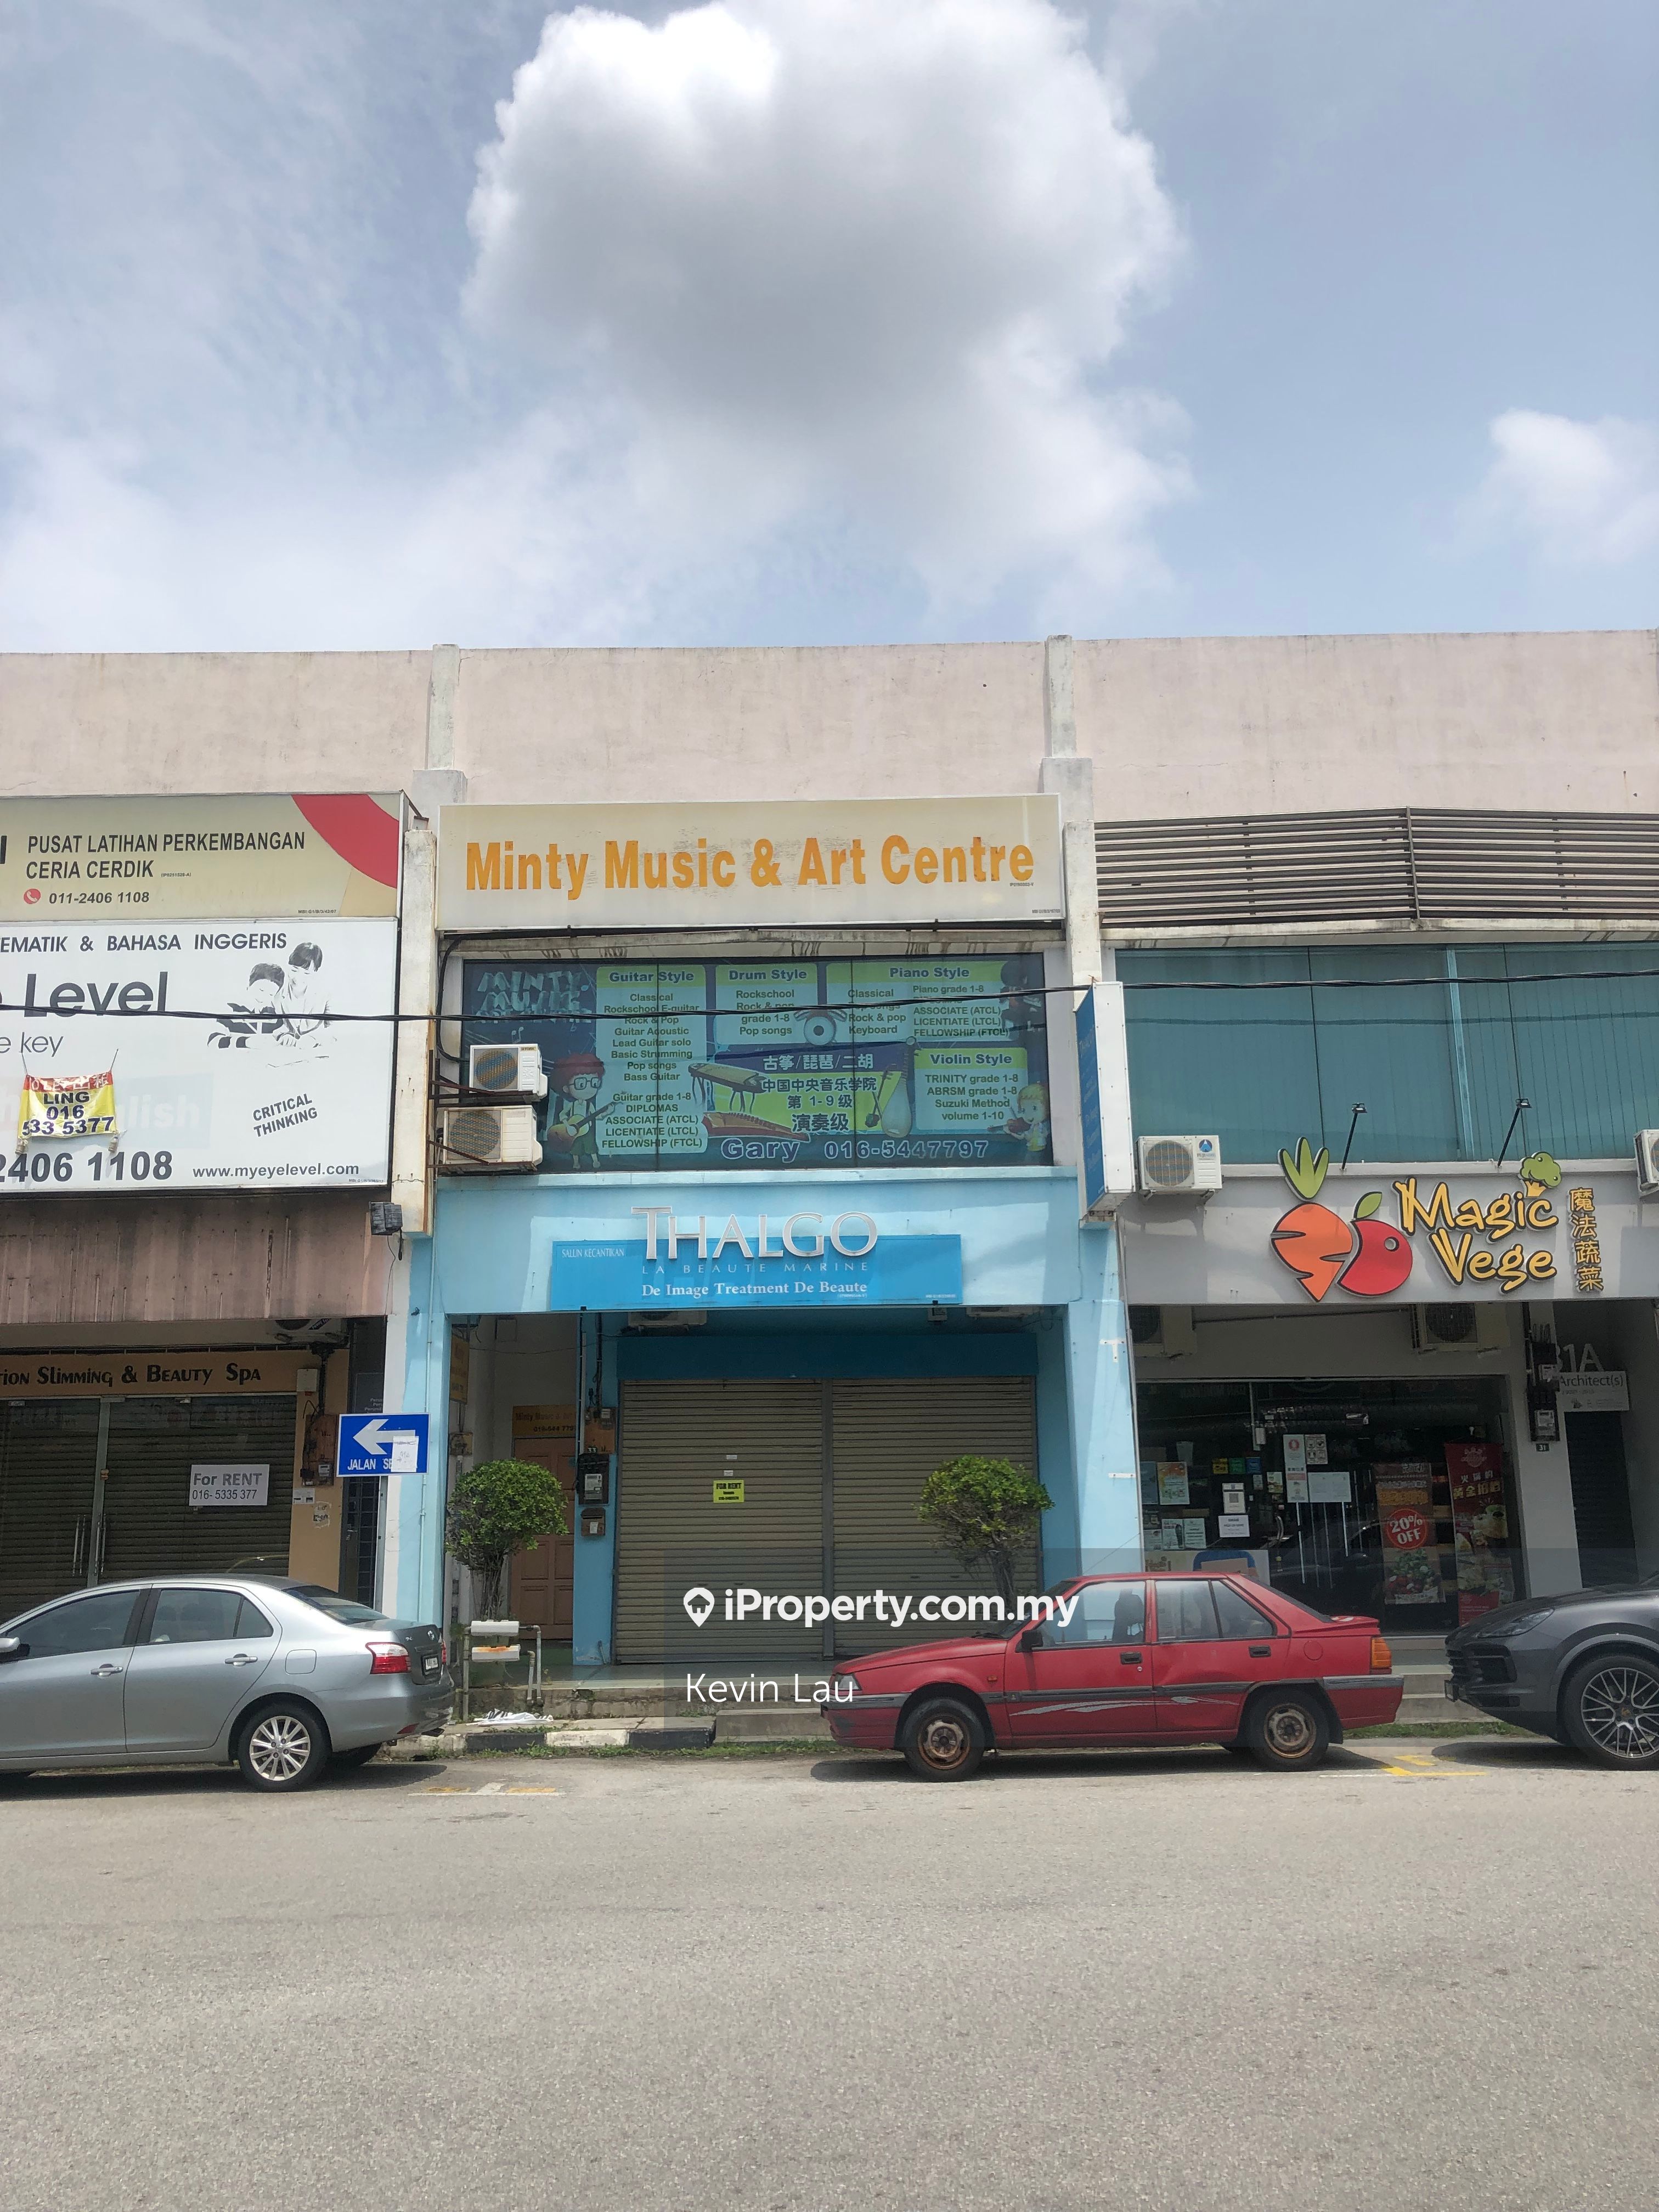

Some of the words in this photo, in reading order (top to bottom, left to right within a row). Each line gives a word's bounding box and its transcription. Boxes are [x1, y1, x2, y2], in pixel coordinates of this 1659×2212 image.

[28, 834, 83, 854] PUSAT
[88, 833, 158, 853] LATIHAN
[162, 832, 306, 852] PERKEMBANGAN
[26, 861, 81, 879] CERIA
[86, 860, 154, 878] CERDIK
[466, 841, 589, 900] Minty
[605, 838, 736, 888] Music
[751, 839, 782, 887] &
[798, 838, 866, 885] Art
[881, 835, 1034, 885] Centre
[49, 893, 112, 904] 011-2406
[118, 891, 150, 904] 1108
[0, 936, 68, 953] EMATIK
[80, 935, 94, 951] &
[107, 934, 181, 951] BAHASA
[194, 933, 287, 950] INGGERIS
[609, 972, 654, 982] Guitar
[658, 971, 694, 983] Style
[729, 970, 766, 980] Drum
[771, 969, 806, 981] Style
[890, 968, 929, 978] Piano
[934, 967, 969, 980] Style
[24, 972, 168, 1017] Level
[736, 990, 794, 998] Rockschool
[848, 989, 894, 998] Classical
[941, 985, 967, 994] grade
[604, 1005, 658, 1013] Rockschool
[913, 1007, 968, 1015] ASSOCIATE
[970, 1006, 1001, 1015] (ATCL)
[661, 1017, 679, 1025] Pop
[741, 1014, 771, 1025] grade
[774, 1014, 789, 1022] 1-8
[849, 1013, 874, 1022] Rock
[887, 1014, 906, 1023] pop
[972, 1017, 1001, 1026] (LTCL)
[614, 1028, 645, 1036] Guitar
[647, 1027, 689, 1035] Acoustic
[740, 1027, 759, 1036] Pop
[761, 1027, 792, 1036] songs
[849, 1025, 898, 1036] Keyboard
[978, 1029, 1008, 1037] (FTCL)
[21, 1032, 64, 1057] key
[639, 1039, 669, 1047] Guitar
[640, 1049, 692, 1059] Strumming
[930, 1054, 971, 1064] Violin
[976, 1054, 1012, 1066] Style
[627, 1062, 646, 1071] Pop
[763, 1054, 874, 1070] 古筝/琵琶/二胡
[650, 1073, 680, 1081] Guitar
[925, 1074, 967, 1083] TRINITY
[969, 1074, 1000, 1085] grade
[1003, 1074, 1018, 1082] 1-8
[763, 1077, 877, 1092] 中国中央音乐学院
[43, 1091, 90, 1104] LING
[646, 1093, 674, 1103] grade
[676, 1092, 691, 1101] 1-8
[927, 1087, 966, 1096] ABRSM
[968, 1087, 998, 1097] grade
[1001, 1086, 1017, 1095] 1-8
[252, 1093, 313, 1122] CRITICAL
[788, 1096, 802, 1109] 第
[838, 1094, 853, 1108] 级
[935, 1099, 969, 1108] Suzuki
[972, 1099, 1010, 1108] Method
[46, 1105, 84, 1120] 016
[626, 1104, 678, 1113] DIPLOMAS
[606, 1116, 664, 1125] ASSOCIATE
[666, 1115, 698, 1125] (ATCL)
[942, 1111, 979, 1120] volume
[981, 1111, 1004, 1120] 1-10
[22, 1119, 54, 1136] 533
[62, 1116, 114, 1134] 5377
[253, 1107, 318, 1138] THINKING
[792, 1113, 849, 1132] 演奏级
[606, 1127, 665, 1136] LICENTIATE
[668, 1127, 698, 1137] (LTCL)
[602, 1139, 667, 1148] FELLOWSHIP
[670, 1138, 702, 1148] (FTCL)
[721, 1138, 800, 1163] Gary
[824, 1140, 988, 1159] 016-5447797
[88, 1151, 172, 1181] 1108
[193, 1162, 359, 1180] www.myeyelevel.com
[1395, 1177, 1559, 1242] Magic
[631, 1206, 878, 1260] THALGO
[1570, 1187, 1604, 1291] 魔法蔬菜
[584, 1248, 624, 1257] KECANTIKAN
[1429, 1228, 1557, 1293] Vege
[642, 1265, 665, 1275] LA
[684, 1263, 766, 1273] BEAUTE
[785, 1262, 868, 1272] MARINE
[642, 1284, 661, 1296] De
[665, 1284, 709, 1299] Image
[713, 1283, 789, 1295] Treatment
[794, 1282, 815, 1293] De
[819, 1281, 867, 1293] Beaute
[121, 1365, 137, 1384] &
[347, 1458, 376, 1470] JALAN
[193, 1473, 218, 1486] For
[222, 1472, 262, 1486] RENT
[192, 1489, 212, 1500] 016-
[215, 1489, 238, 1500] 5335
[240, 1489, 258, 1499] 377
[1390, 1514, 1423, 1533] 20%
[1397, 1528, 1421, 1544] OFF
